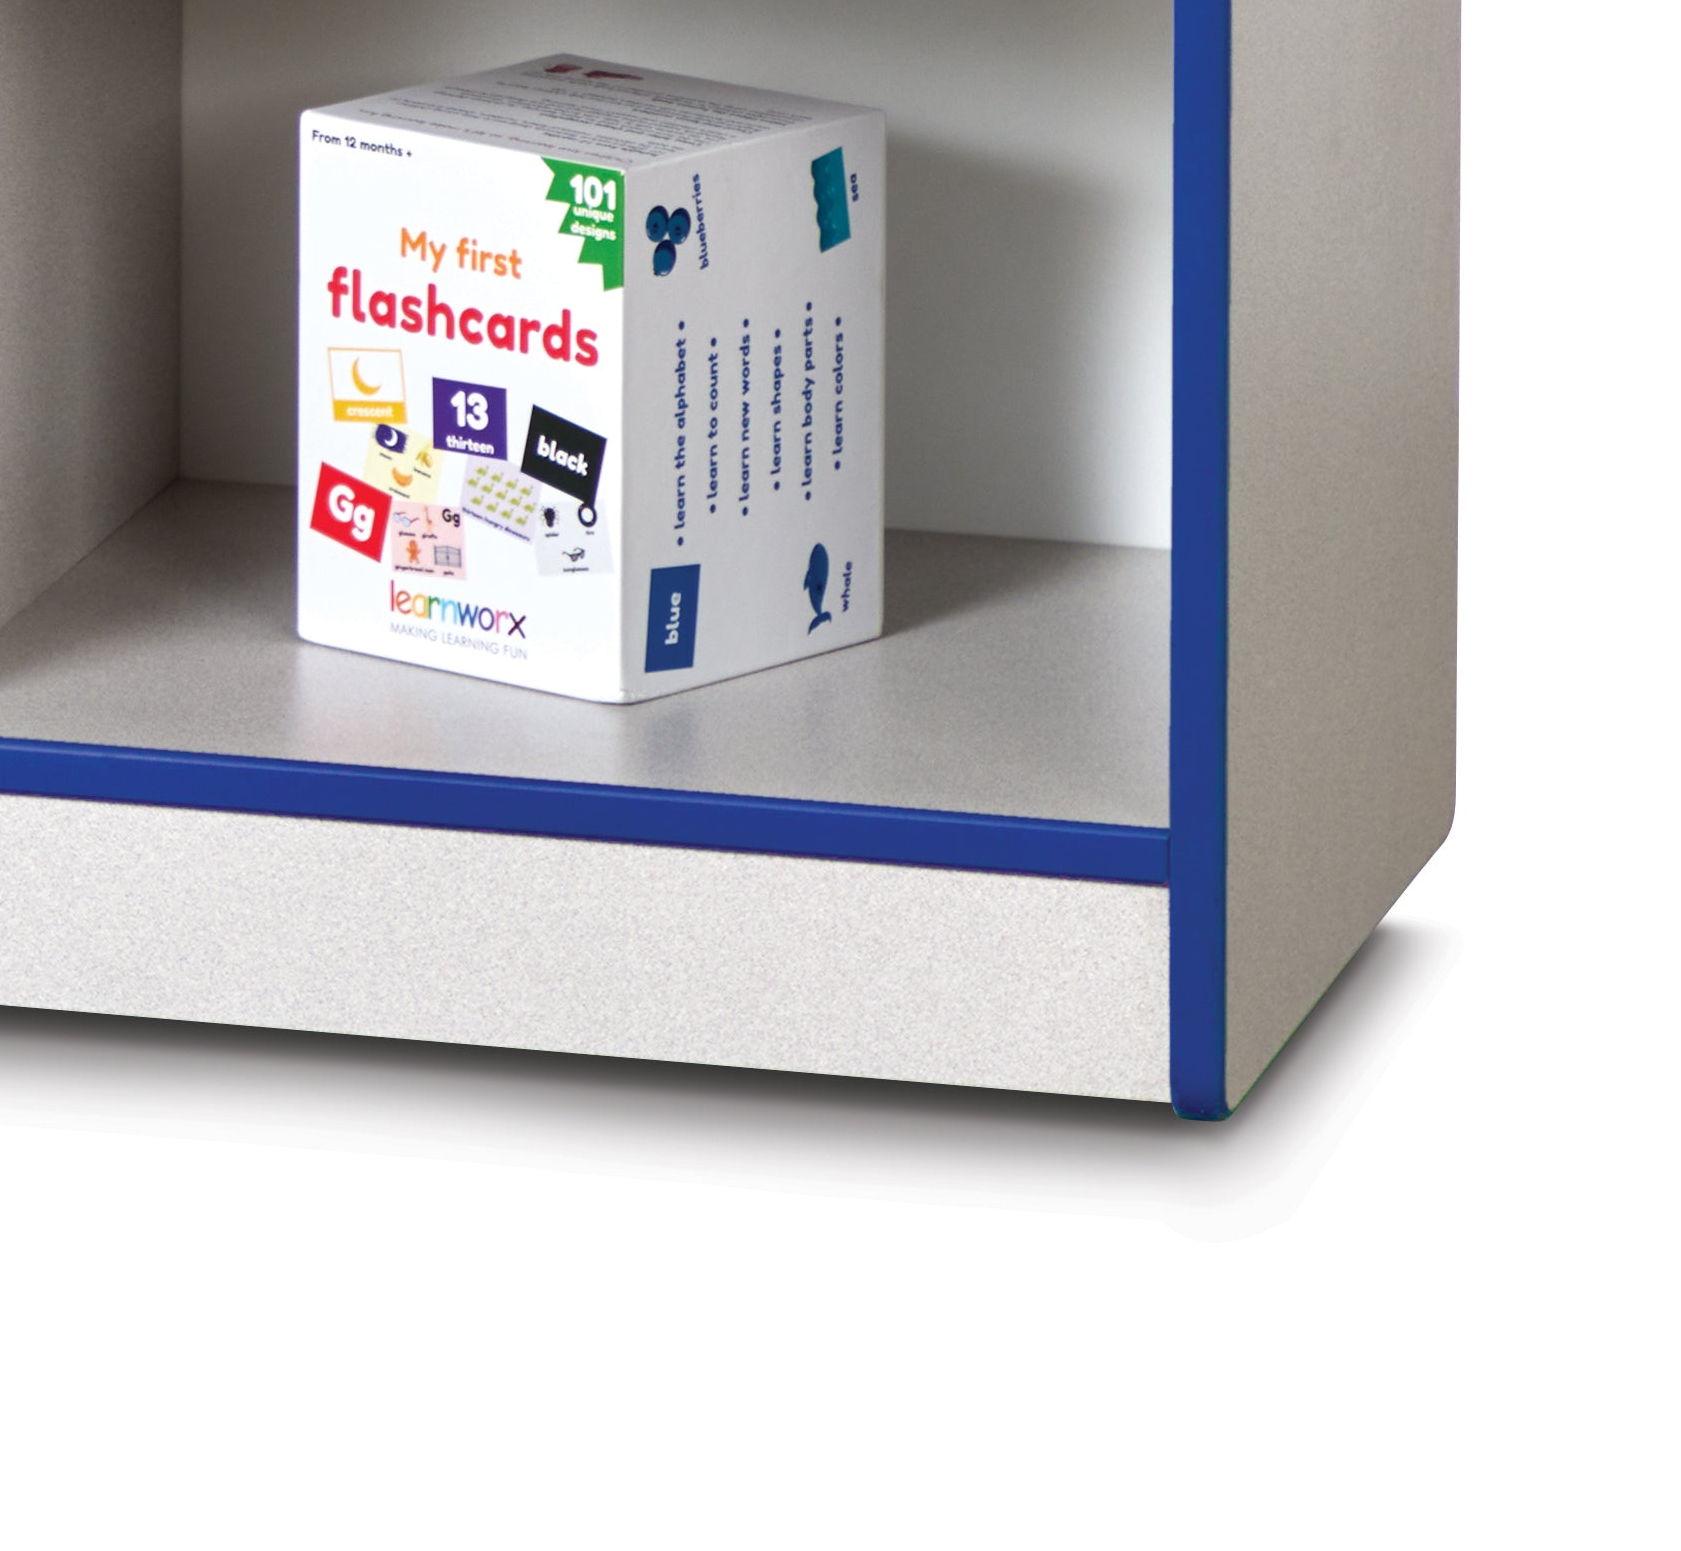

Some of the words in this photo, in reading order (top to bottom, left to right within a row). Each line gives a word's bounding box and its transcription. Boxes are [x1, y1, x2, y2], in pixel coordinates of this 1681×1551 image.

[311, 129, 341, 146] From
[344, 136, 357, 149] 12
[360, 140, 403, 157] months
[569, 173, 616, 211] 101
[850, 173, 860, 202] sea
[570, 220, 617, 241] designs
[572, 206, 615, 223] unique
[691, 173, 710, 270] blueberries
[401, 227, 447, 273] My
[455, 236, 524, 279] first
[327, 266, 600, 367] flashcards
[738, 335, 751, 395] words
[801, 317, 816, 371] parts
[831, 333, 844, 395] colors
[673, 339, 689, 429] alphabet
[707, 353, 719, 411] count
[769, 345, 785, 415] shapes
[800, 378, 816, 427] body
[345, 406, 395, 418] crescent
[450, 390, 489, 431] 13
[707, 416, 718, 438] to
[740, 401, 751, 442] new
[831, 401, 844, 454] learn
[445, 434, 495, 455] thirteen
[537, 434, 589, 477] black
[674, 435, 687, 468] the
[770, 420, 782, 475] learn
[800, 432, 813, 486] learn
[706, 444, 719, 498] learn
[738, 448, 751, 501] learn
[328, 483, 376, 542] Gg
[441, 507, 461, 527] Gg
[674, 475, 687, 529] learn
[390, 579, 527, 639] learnworx
[840, 562, 853, 613] whale
[390, 622, 438, 642] MAKING
[441, 631, 500, 655] LEARNING
[503, 644, 528, 660] FUN
[664, 592, 683, 646] blue
